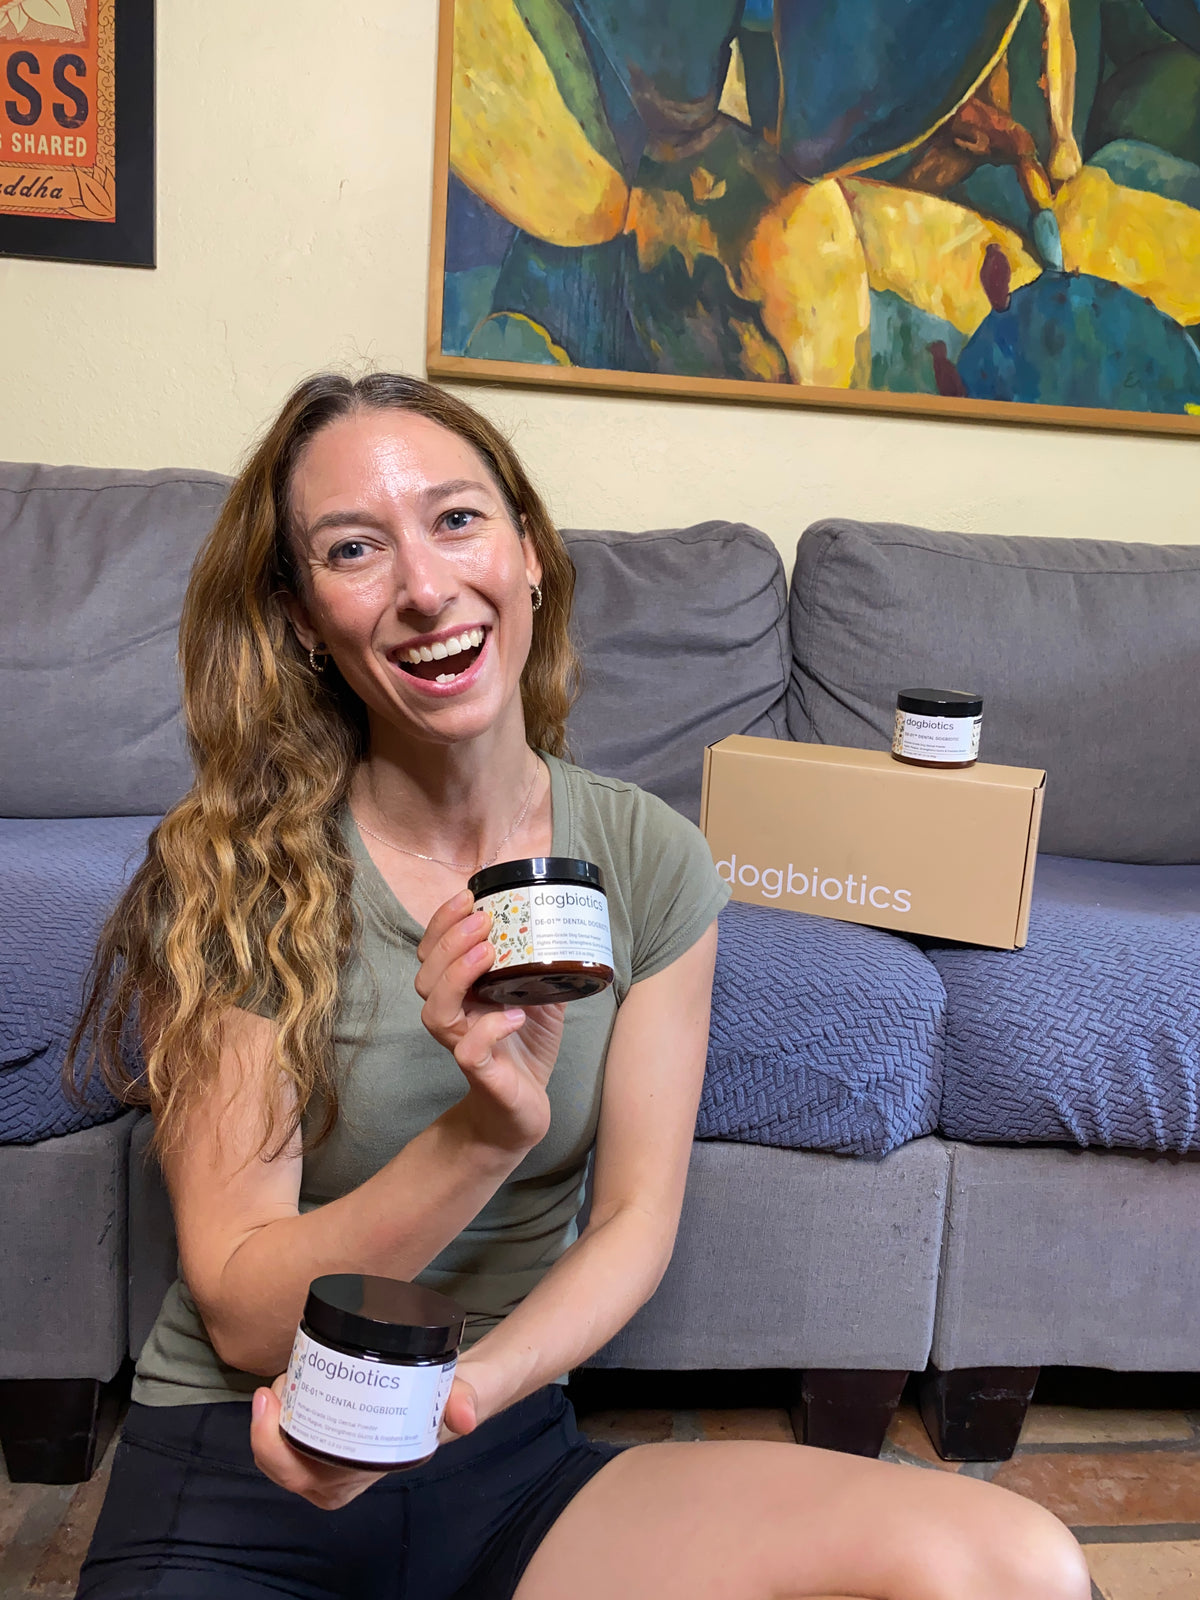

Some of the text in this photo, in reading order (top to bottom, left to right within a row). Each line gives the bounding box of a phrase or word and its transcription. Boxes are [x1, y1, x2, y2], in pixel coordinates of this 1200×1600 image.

[11, 131, 88, 158] SHARED
[0, 175, 64, 199] ddha
[906, 717, 955, 731] dogbiotics
[716, 854, 912, 913] dogbiotics
[534, 891, 604, 912] dogbiotics
[562, 917, 588, 927] DENTAL
[308, 1351, 401, 1390] dogbiotics
[325, 1393, 357, 1410] DENTAL
[359, 1403, 409, 1416] DOGBIOTIC
